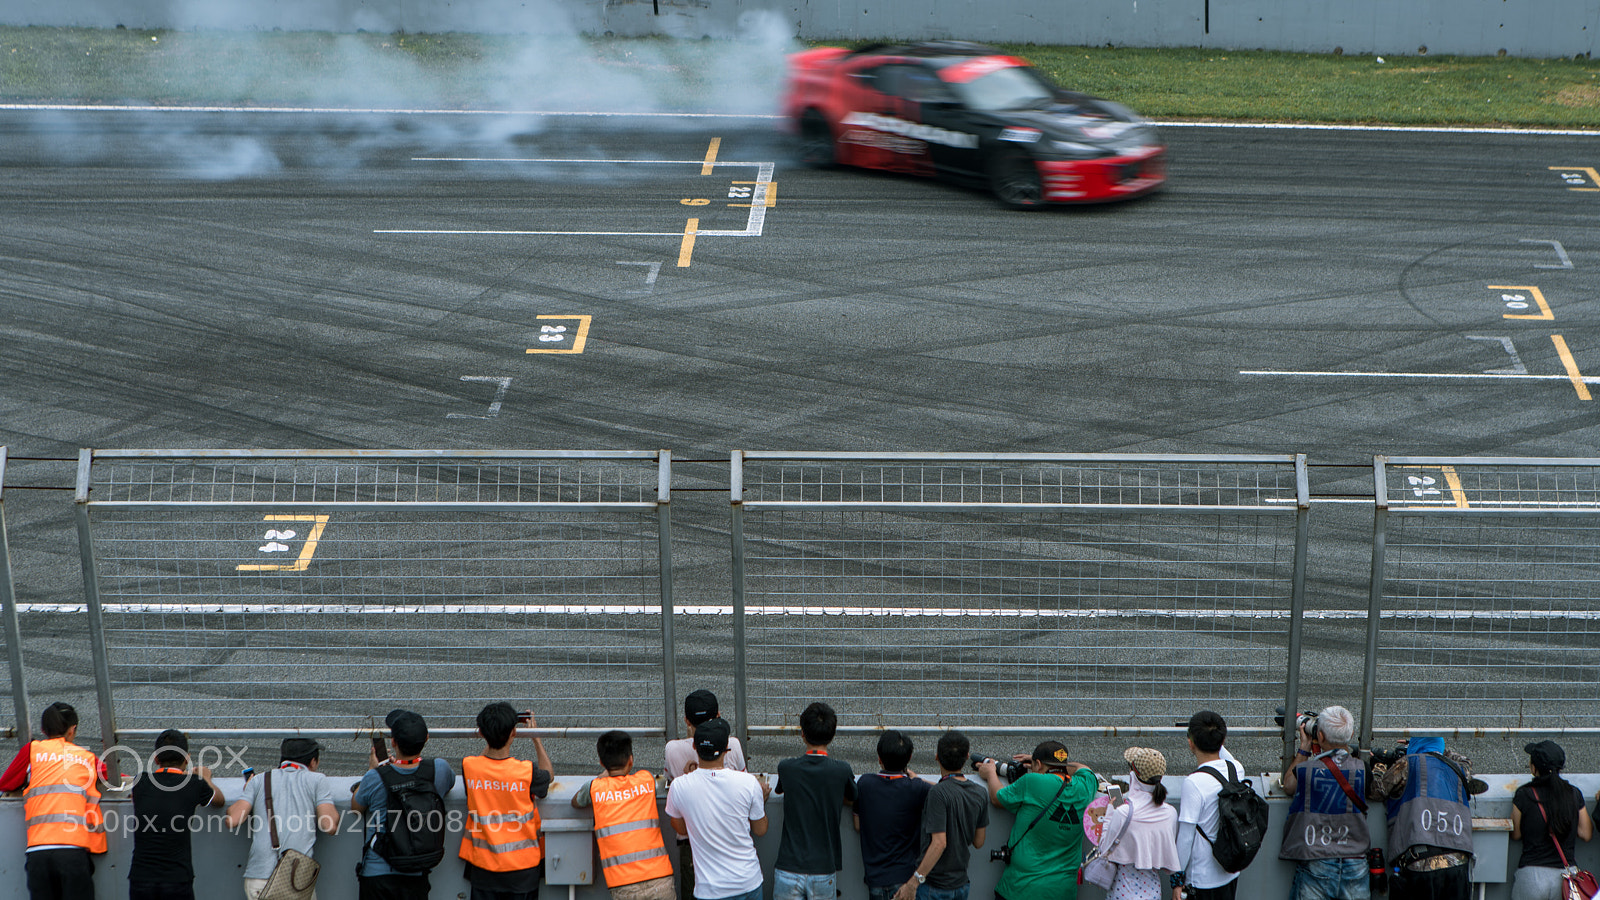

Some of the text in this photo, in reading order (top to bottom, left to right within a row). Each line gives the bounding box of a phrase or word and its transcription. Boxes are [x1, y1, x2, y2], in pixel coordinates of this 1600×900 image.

[728, 186, 752, 198] 22
[1501, 294, 1529, 309] 20
[538, 325, 567, 342] 23
[258, 529, 297, 553] 24
[467, 778, 526, 792] MARSHAL
[595, 783, 654, 803] MARSHAL
[1421, 809, 1463, 836] 050
[1304, 824, 1349, 846] 082
